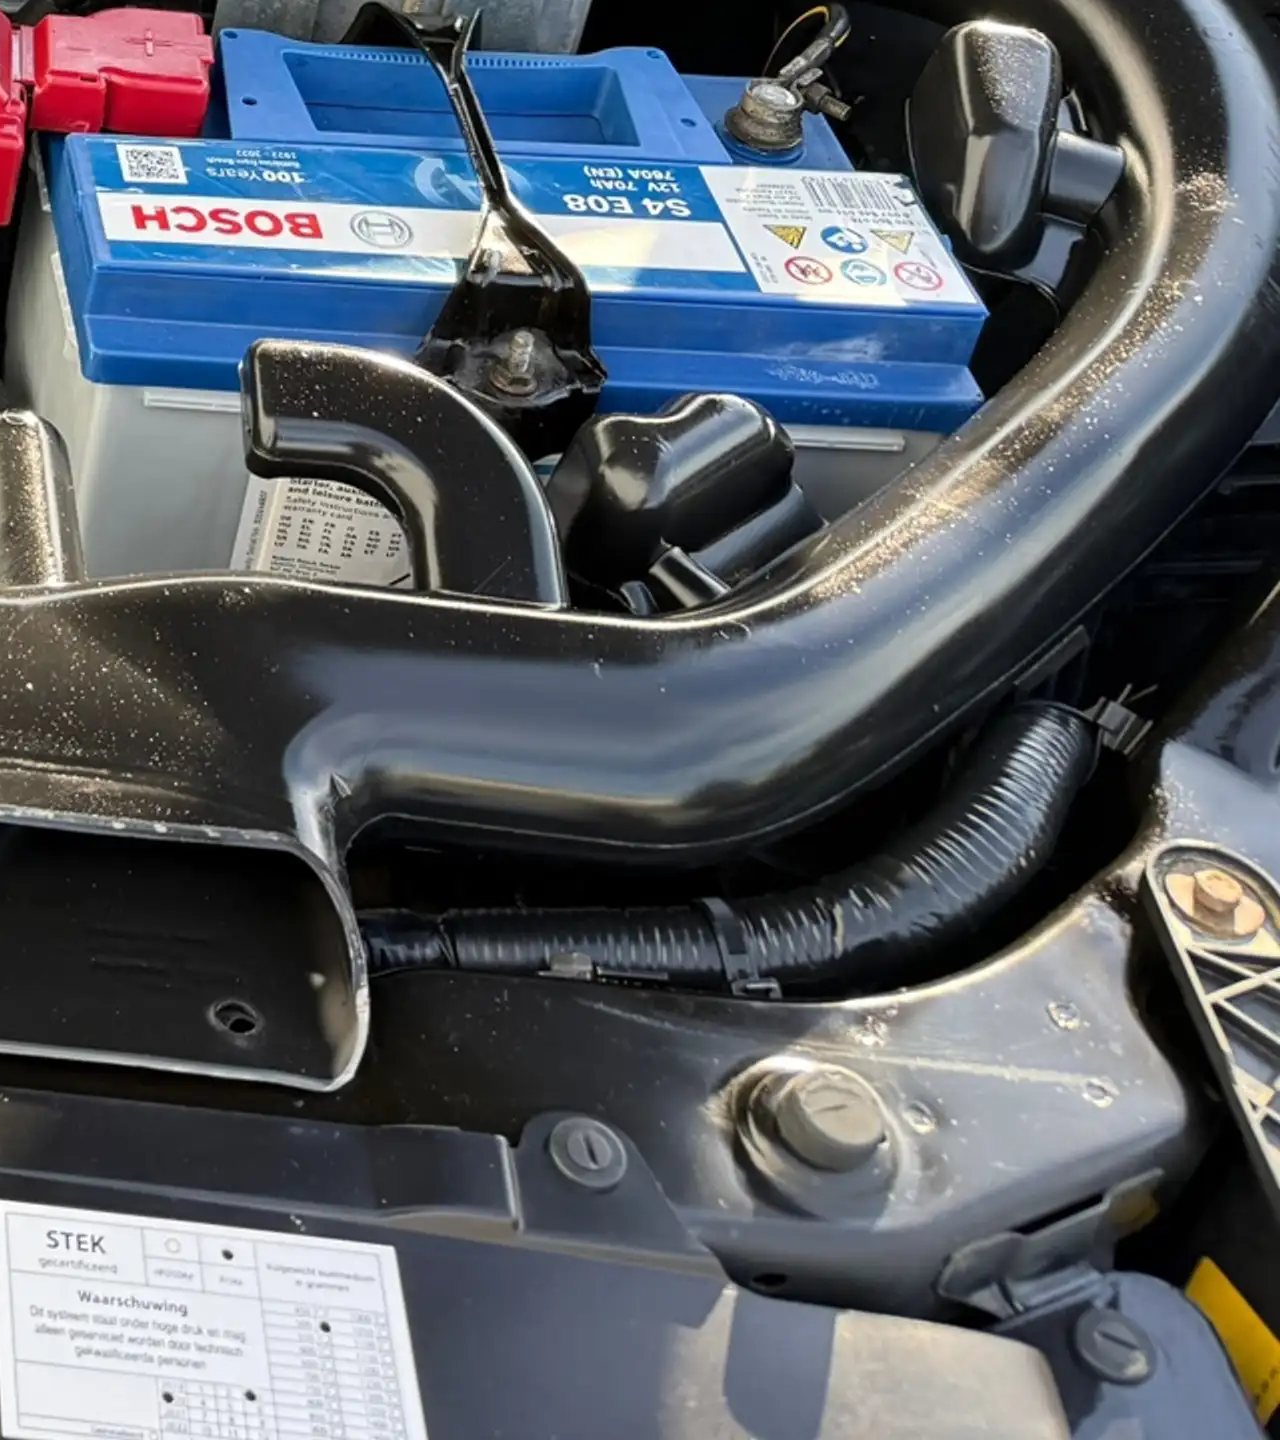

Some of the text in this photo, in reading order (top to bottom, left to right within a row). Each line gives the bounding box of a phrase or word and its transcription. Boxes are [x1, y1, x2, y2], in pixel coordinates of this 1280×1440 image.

[206, 167, 306, 184] 100 Years
[583, 165, 676, 181] 760A (EN)
[589, 178, 681, 193] 12V 70Ah
[562, 194, 692, 217] S4 E08
[131, 205, 324, 239] BOSCH
[45, 1229, 107, 1255] STEK
[77, 1289, 189, 1317] Waarschuwing
